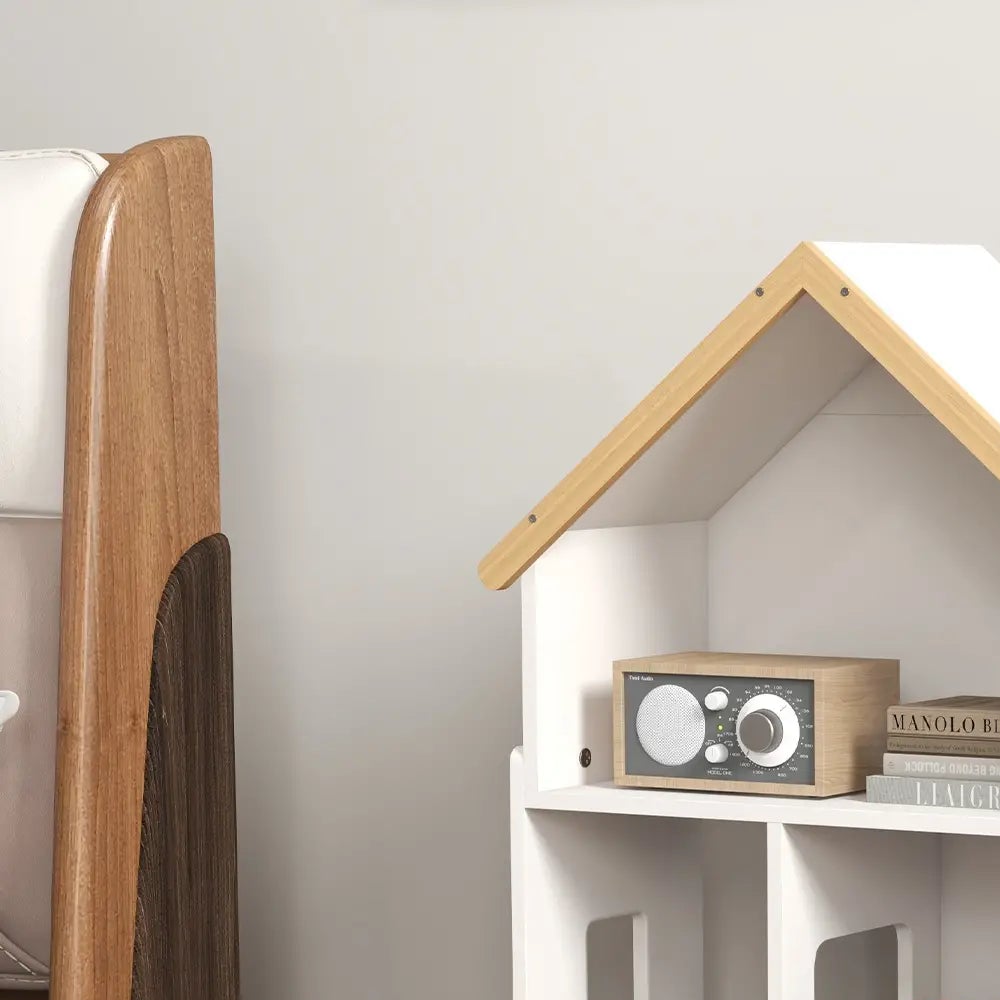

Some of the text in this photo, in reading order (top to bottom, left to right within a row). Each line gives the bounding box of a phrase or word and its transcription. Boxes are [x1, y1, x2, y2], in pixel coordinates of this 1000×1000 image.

[892, 714, 975, 733] MANOLO
[904, 760, 946, 774] POLLOCK
[950, 764, 986, 776] BEYOND
